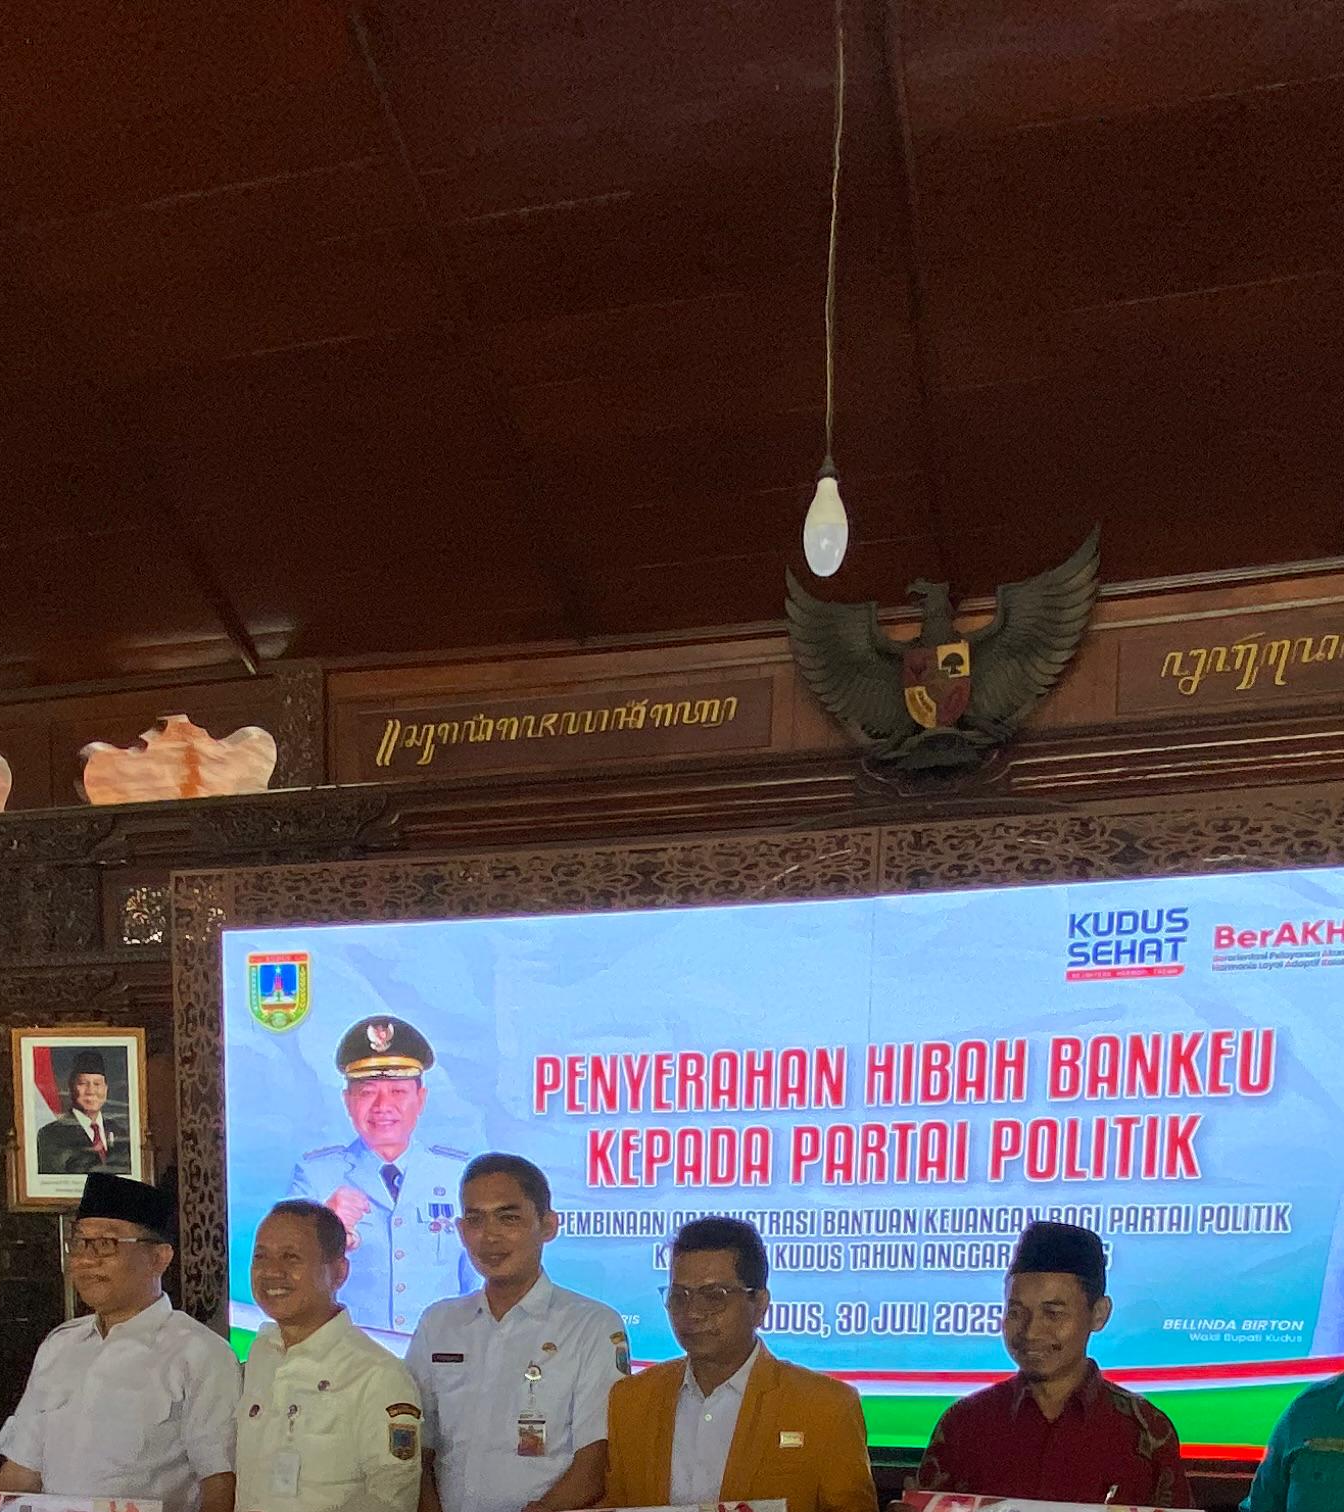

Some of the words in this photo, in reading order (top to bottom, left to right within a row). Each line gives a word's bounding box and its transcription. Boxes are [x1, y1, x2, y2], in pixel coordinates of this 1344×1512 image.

[1068, 906, 1190, 939] KUDUS
[1067, 935, 1187, 967] SEHAT
[535, 1046, 846, 1114] PENYERAHAN
[865, 1038, 1028, 1106] HIBAH
[1049, 1029, 1276, 1100] BANKEU
[586, 1126, 771, 1188] KEPADA
[791, 1121, 968, 1186] PARTAI
[992, 1114, 1203, 1180] POLITIK
[557, 1211, 665, 1236] PEMBINAAN
[823, 1208, 917, 1235] BANTUAN
[1110, 1205, 1191, 1233] PARTAI
[1199, 1204, 1291, 1232] POLITIK
[775, 1244, 842, 1270] KUDUS
[850, 1243, 915, 1270] TAHUN
[923, 1242, 1010, 1269] ANGGAR
[760, 1303, 830, 1336] UDUS,
[838, 1302, 867, 1333] 30
[873, 1302, 927, 1333] JULI
[935, 1302, 1003, 1334] 2025
[1162, 1318, 1236, 1331] BELLINDA
[1241, 1319, 1304, 1332] BIRTON
[1224, 1332, 1262, 1343] Bupati
[1265, 1333, 1303, 1343] Kudus
